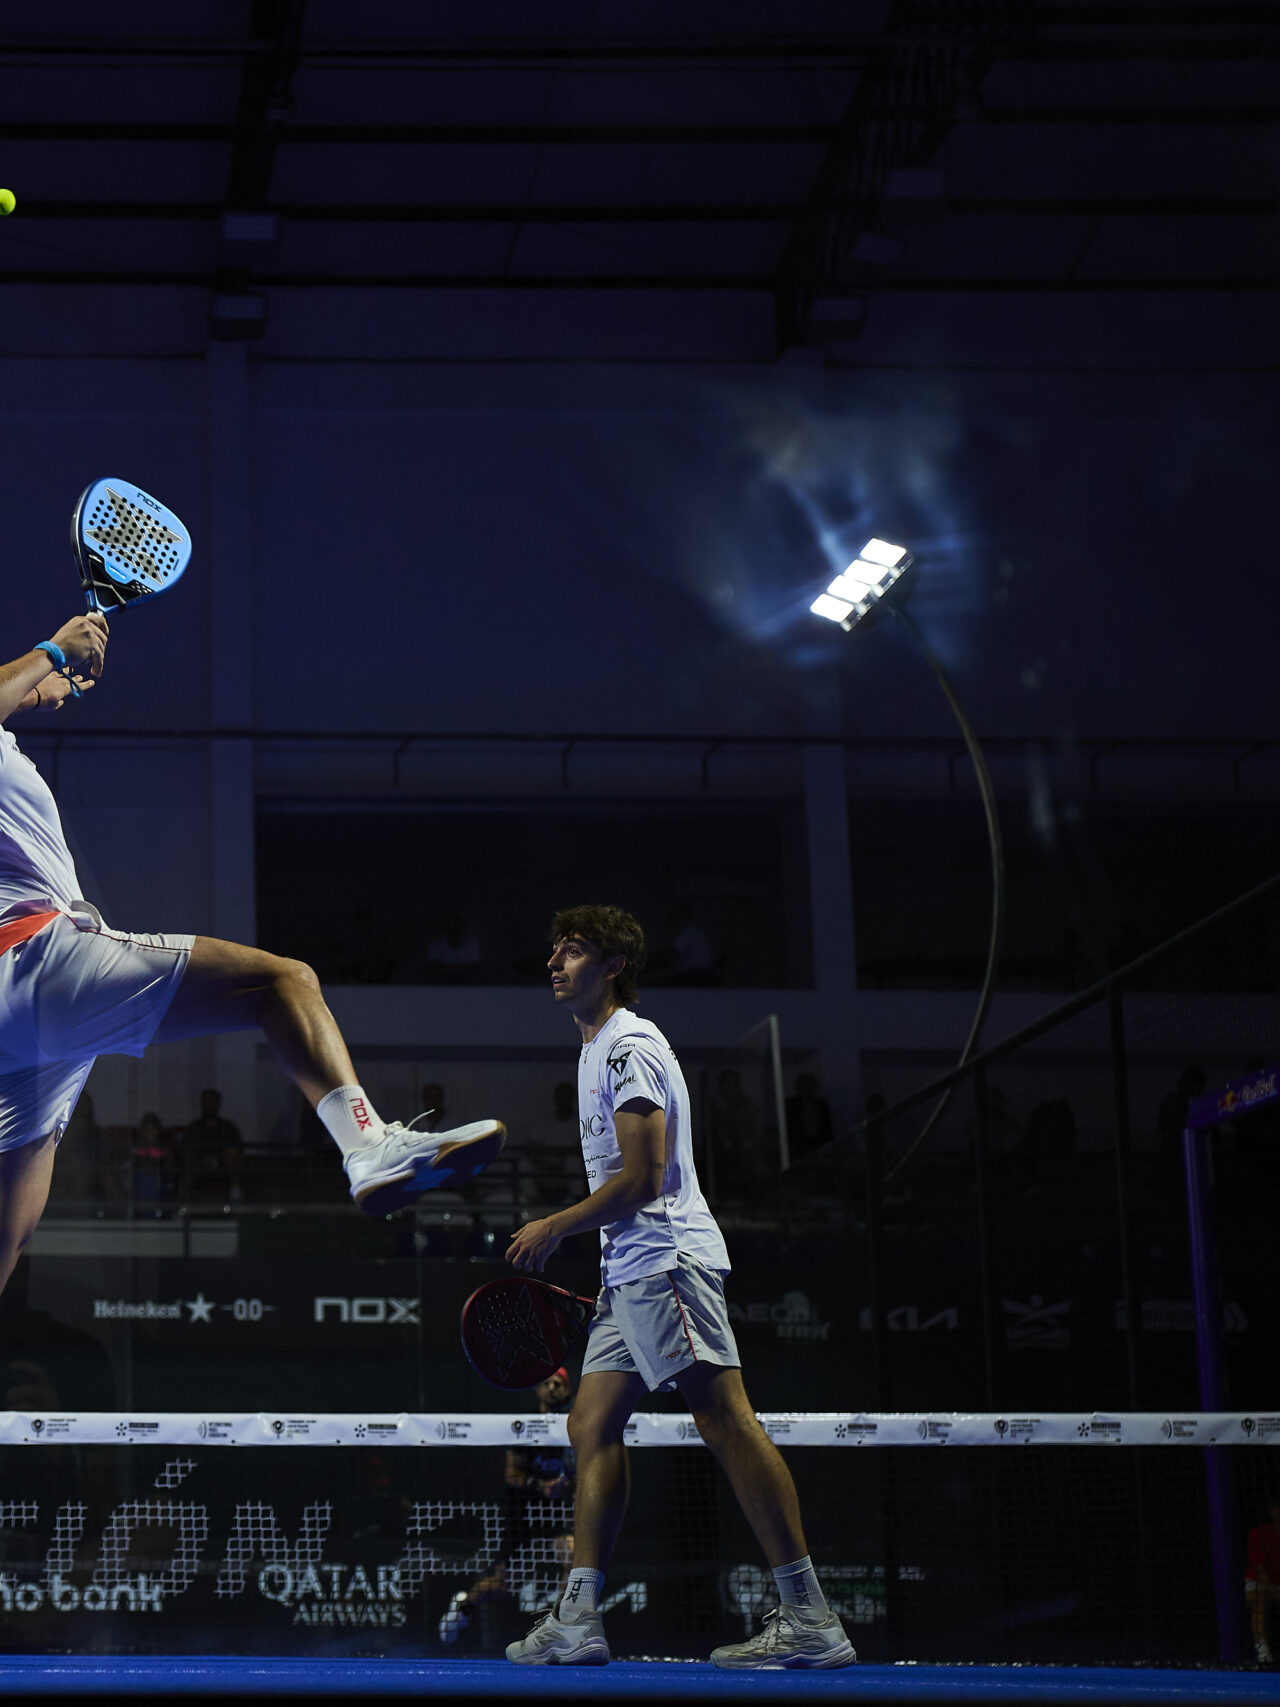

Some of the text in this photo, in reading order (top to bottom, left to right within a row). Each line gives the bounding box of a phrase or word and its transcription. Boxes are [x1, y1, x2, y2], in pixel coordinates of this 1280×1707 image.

[350, 1097, 372, 1131] nox
[93, 1298, 181, 1319] Heineken
[51, 1573, 163, 1613] bank
[257, 1563, 404, 1608] QATAR
[292, 1602, 407, 1628] AIRWAYS
